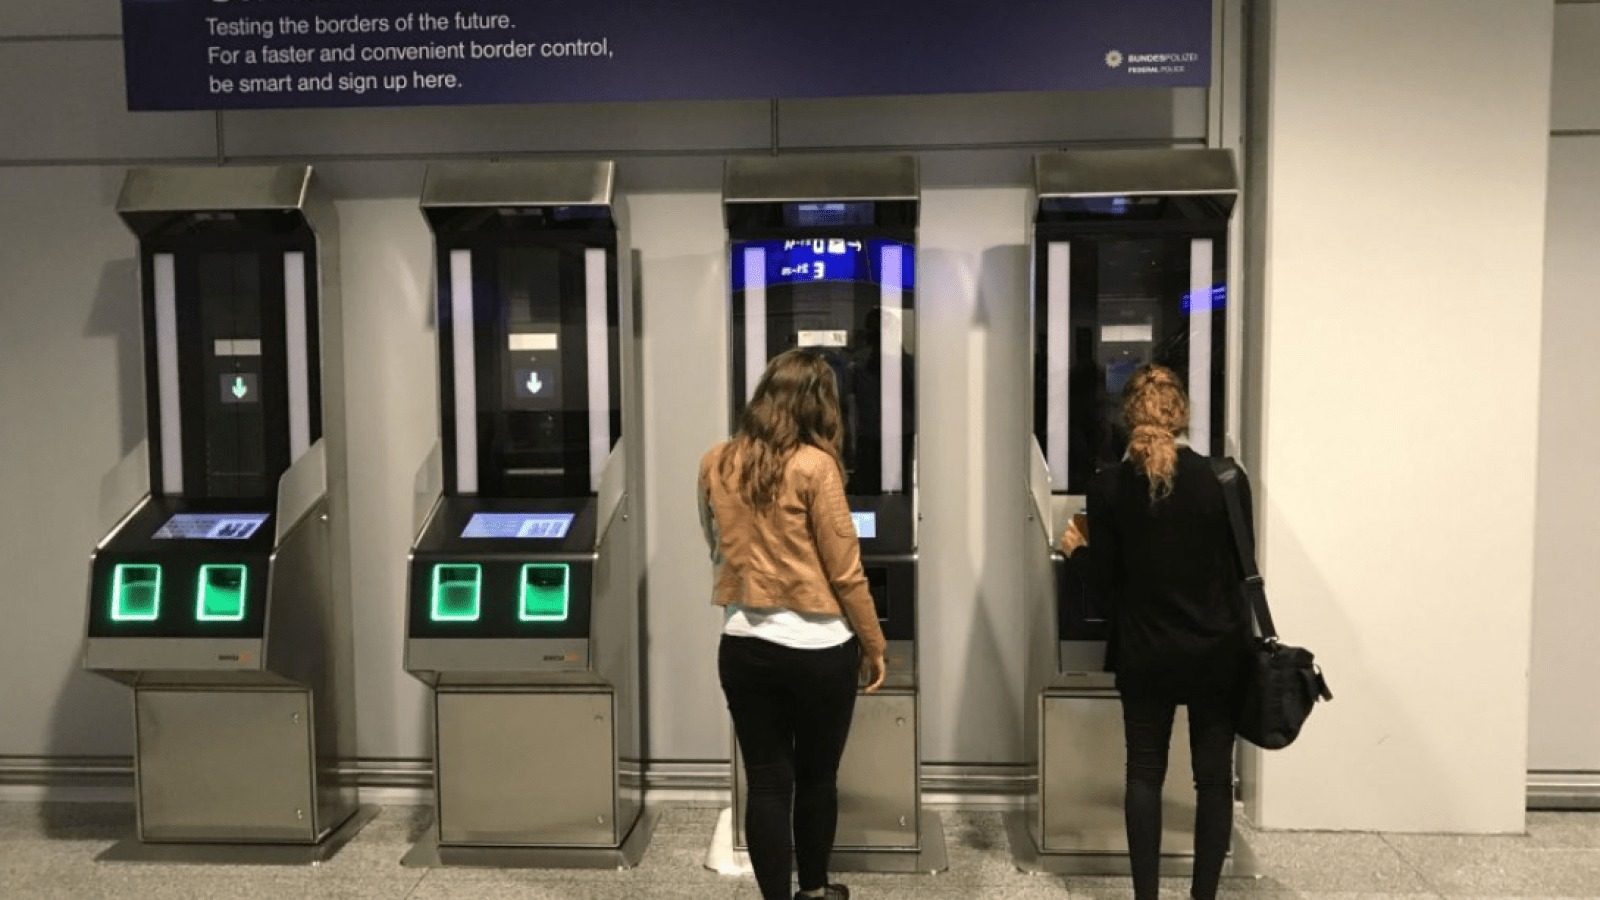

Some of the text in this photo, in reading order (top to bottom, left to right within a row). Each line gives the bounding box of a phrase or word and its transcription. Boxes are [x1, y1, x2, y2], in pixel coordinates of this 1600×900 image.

[205, 11, 517, 39] Testing the borders of the future.
[207, 37, 614, 65] For a faster and convenient border control,
[1127, 53, 1199, 63] BUNDESPOLIZEI
[1127, 65, 1185, 74] FEDERAL POLICE
[209, 70, 463, 95] be smart and sign up here.
